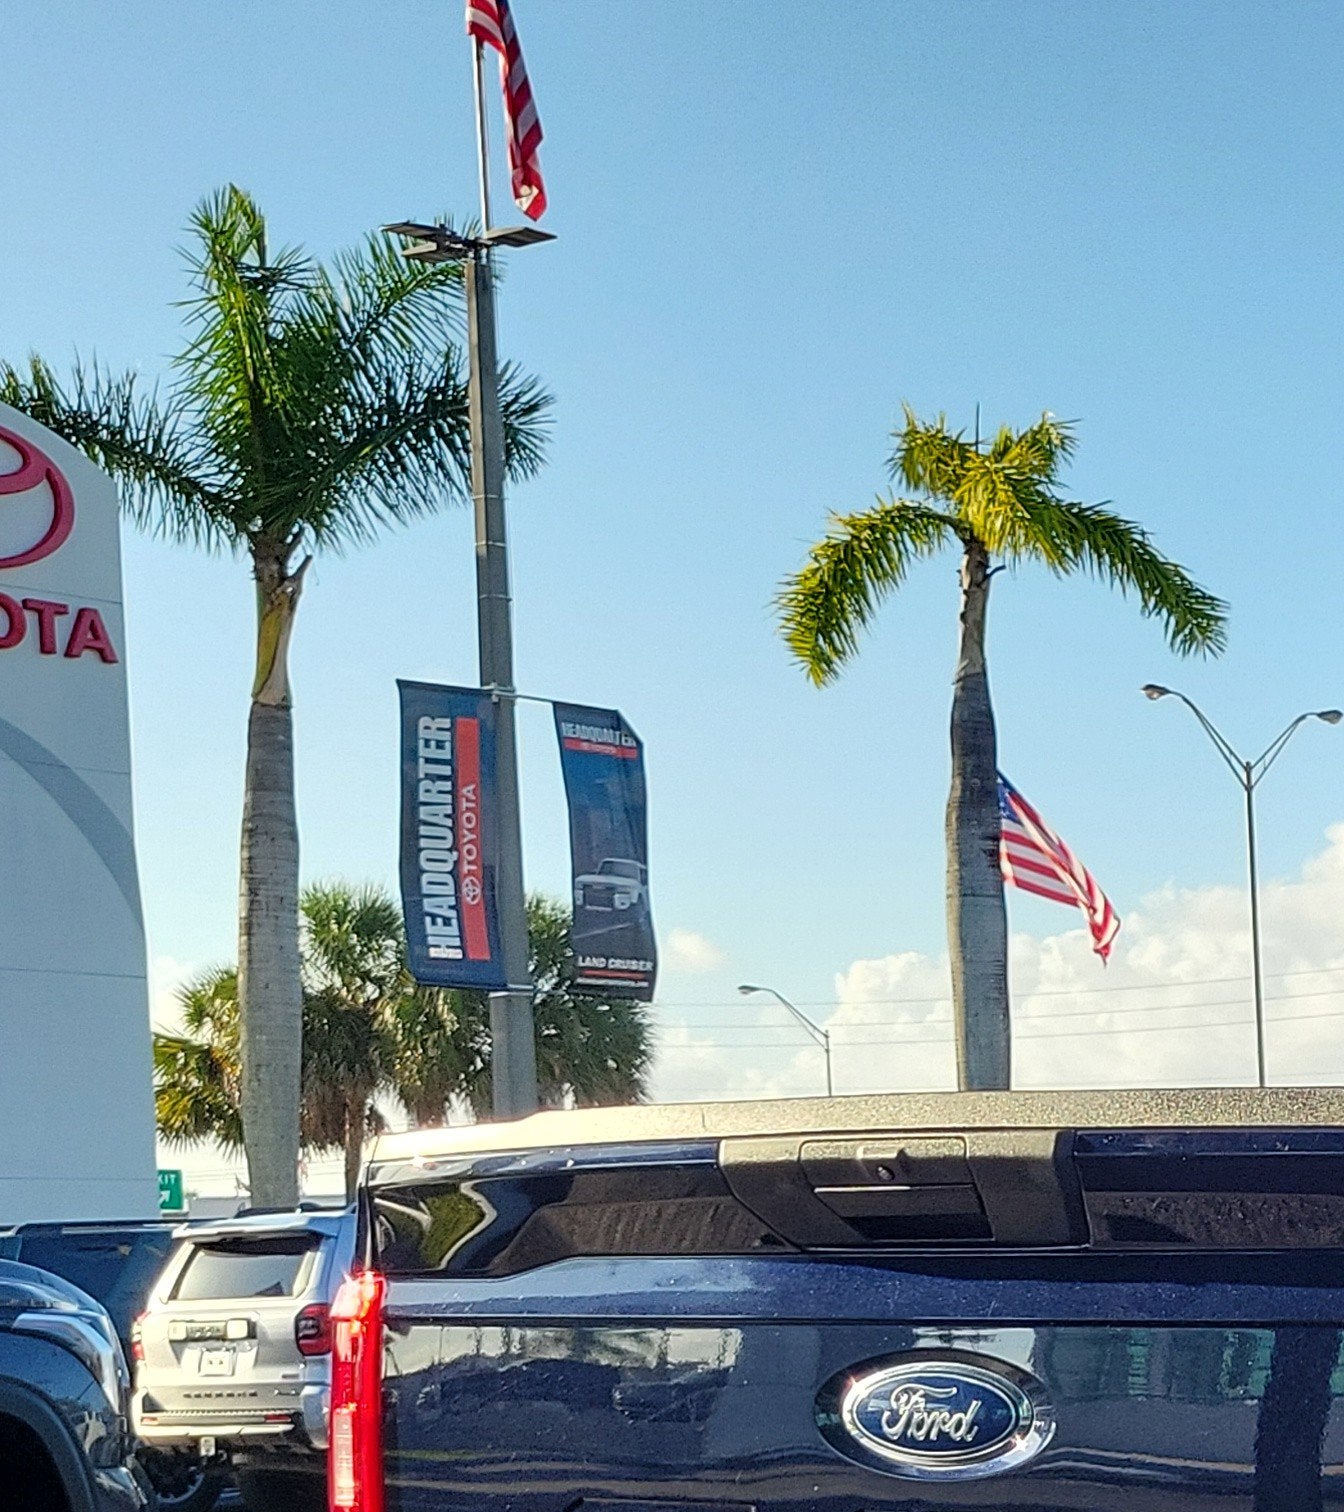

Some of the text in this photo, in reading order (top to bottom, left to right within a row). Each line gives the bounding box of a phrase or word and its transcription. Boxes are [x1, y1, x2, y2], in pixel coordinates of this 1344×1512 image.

[418, 715, 464, 959] HEADQUARTER
[461, 783, 478, 875] TOYOTA
[577, 955, 607, 968] LAND
[881, 1382, 983, 1443] Ford
